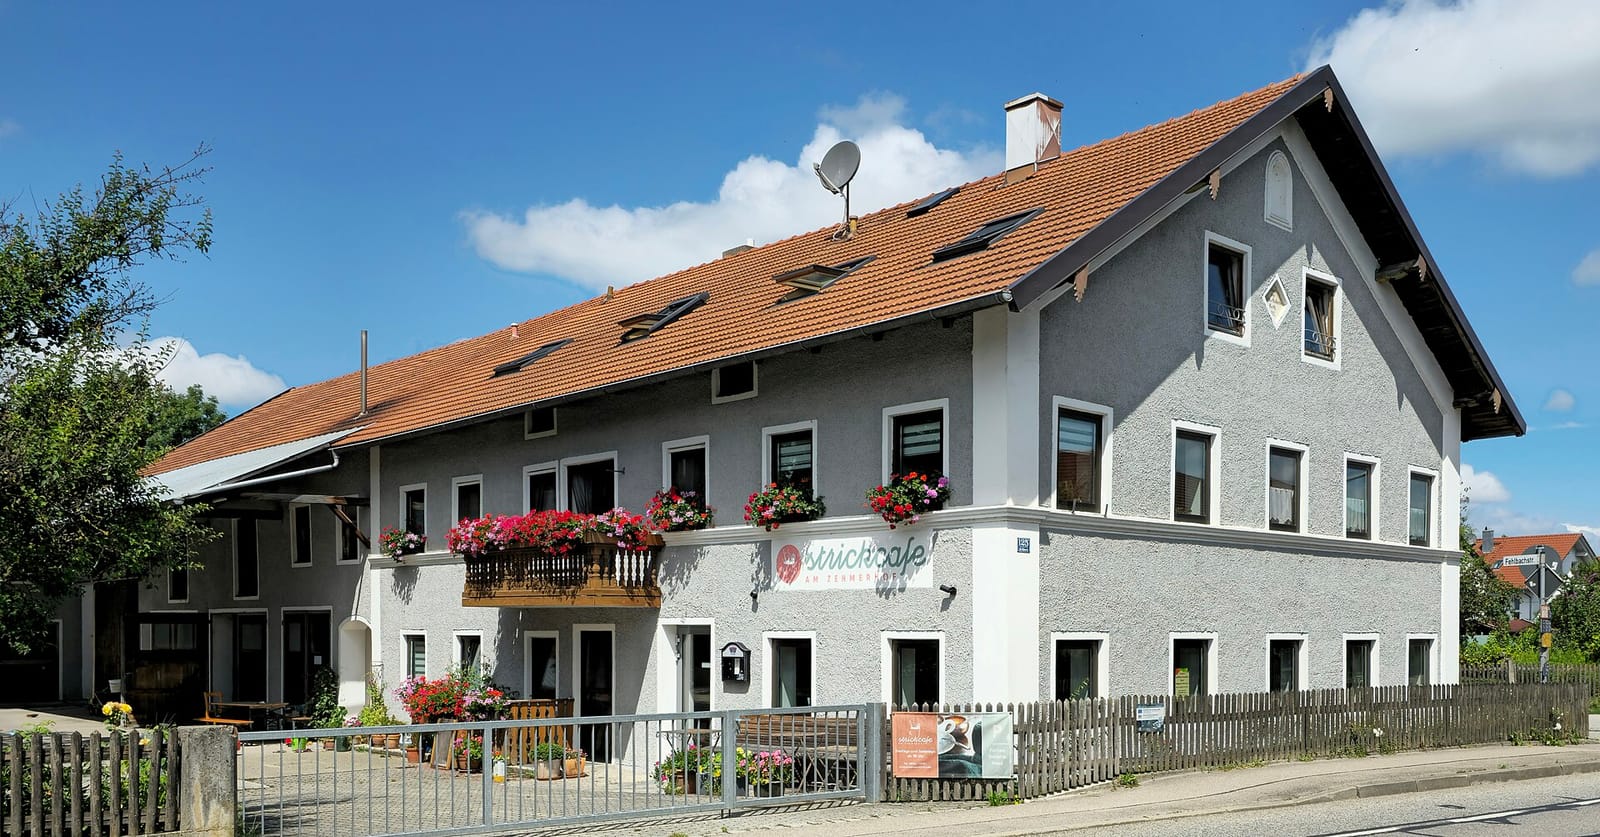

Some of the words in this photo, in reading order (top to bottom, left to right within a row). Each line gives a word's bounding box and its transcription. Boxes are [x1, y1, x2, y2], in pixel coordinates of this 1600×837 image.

[804, 536, 926, 576] strickcafe
[805, 575, 819, 584] AM
[827, 573, 897, 583] ZEHMERHOF
